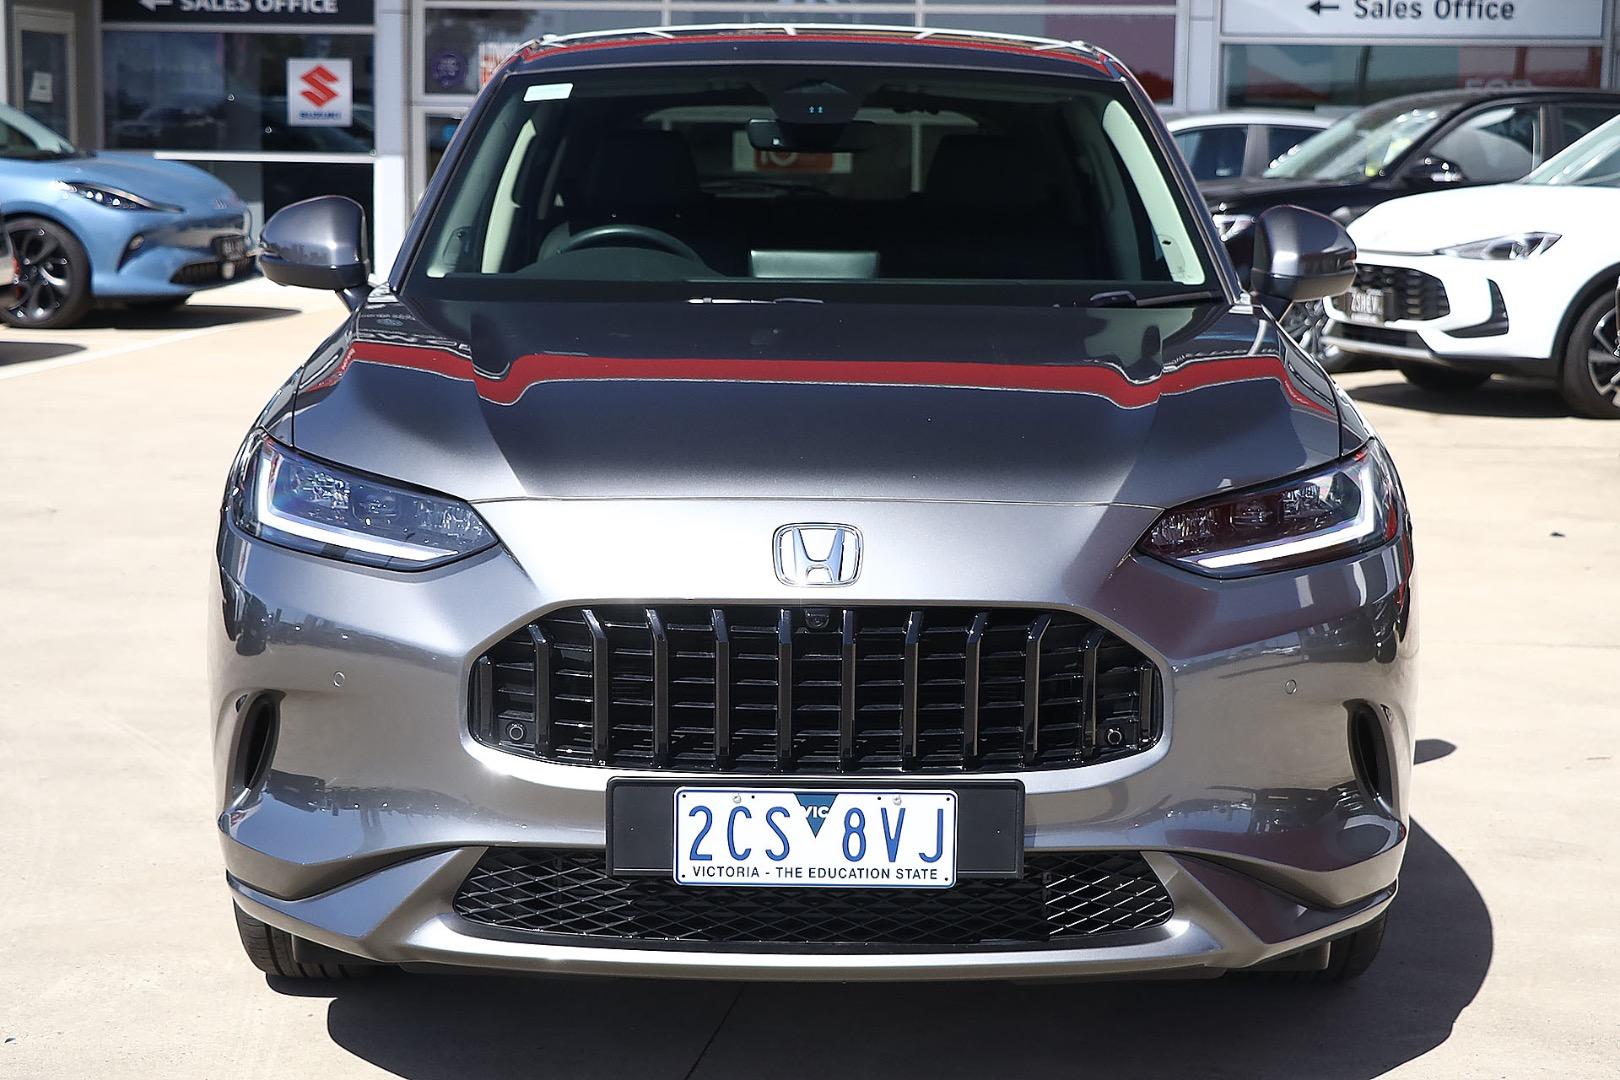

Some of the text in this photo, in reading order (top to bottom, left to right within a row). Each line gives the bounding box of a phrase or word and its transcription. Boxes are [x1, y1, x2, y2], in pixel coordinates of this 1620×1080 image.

[180, 0, 338, 13] SALES OFFICE
[1353, 0, 1515, 20] Sales Office
[803, 805, 830, 818] VIC
[688, 805, 945, 863] 2CS 8VJ
[692, 865, 760, 878] VICTORIA
[776, 867, 803, 879] THE
[808, 868, 890, 881] EDUCATION
[895, 869, 938, 881] STATE
